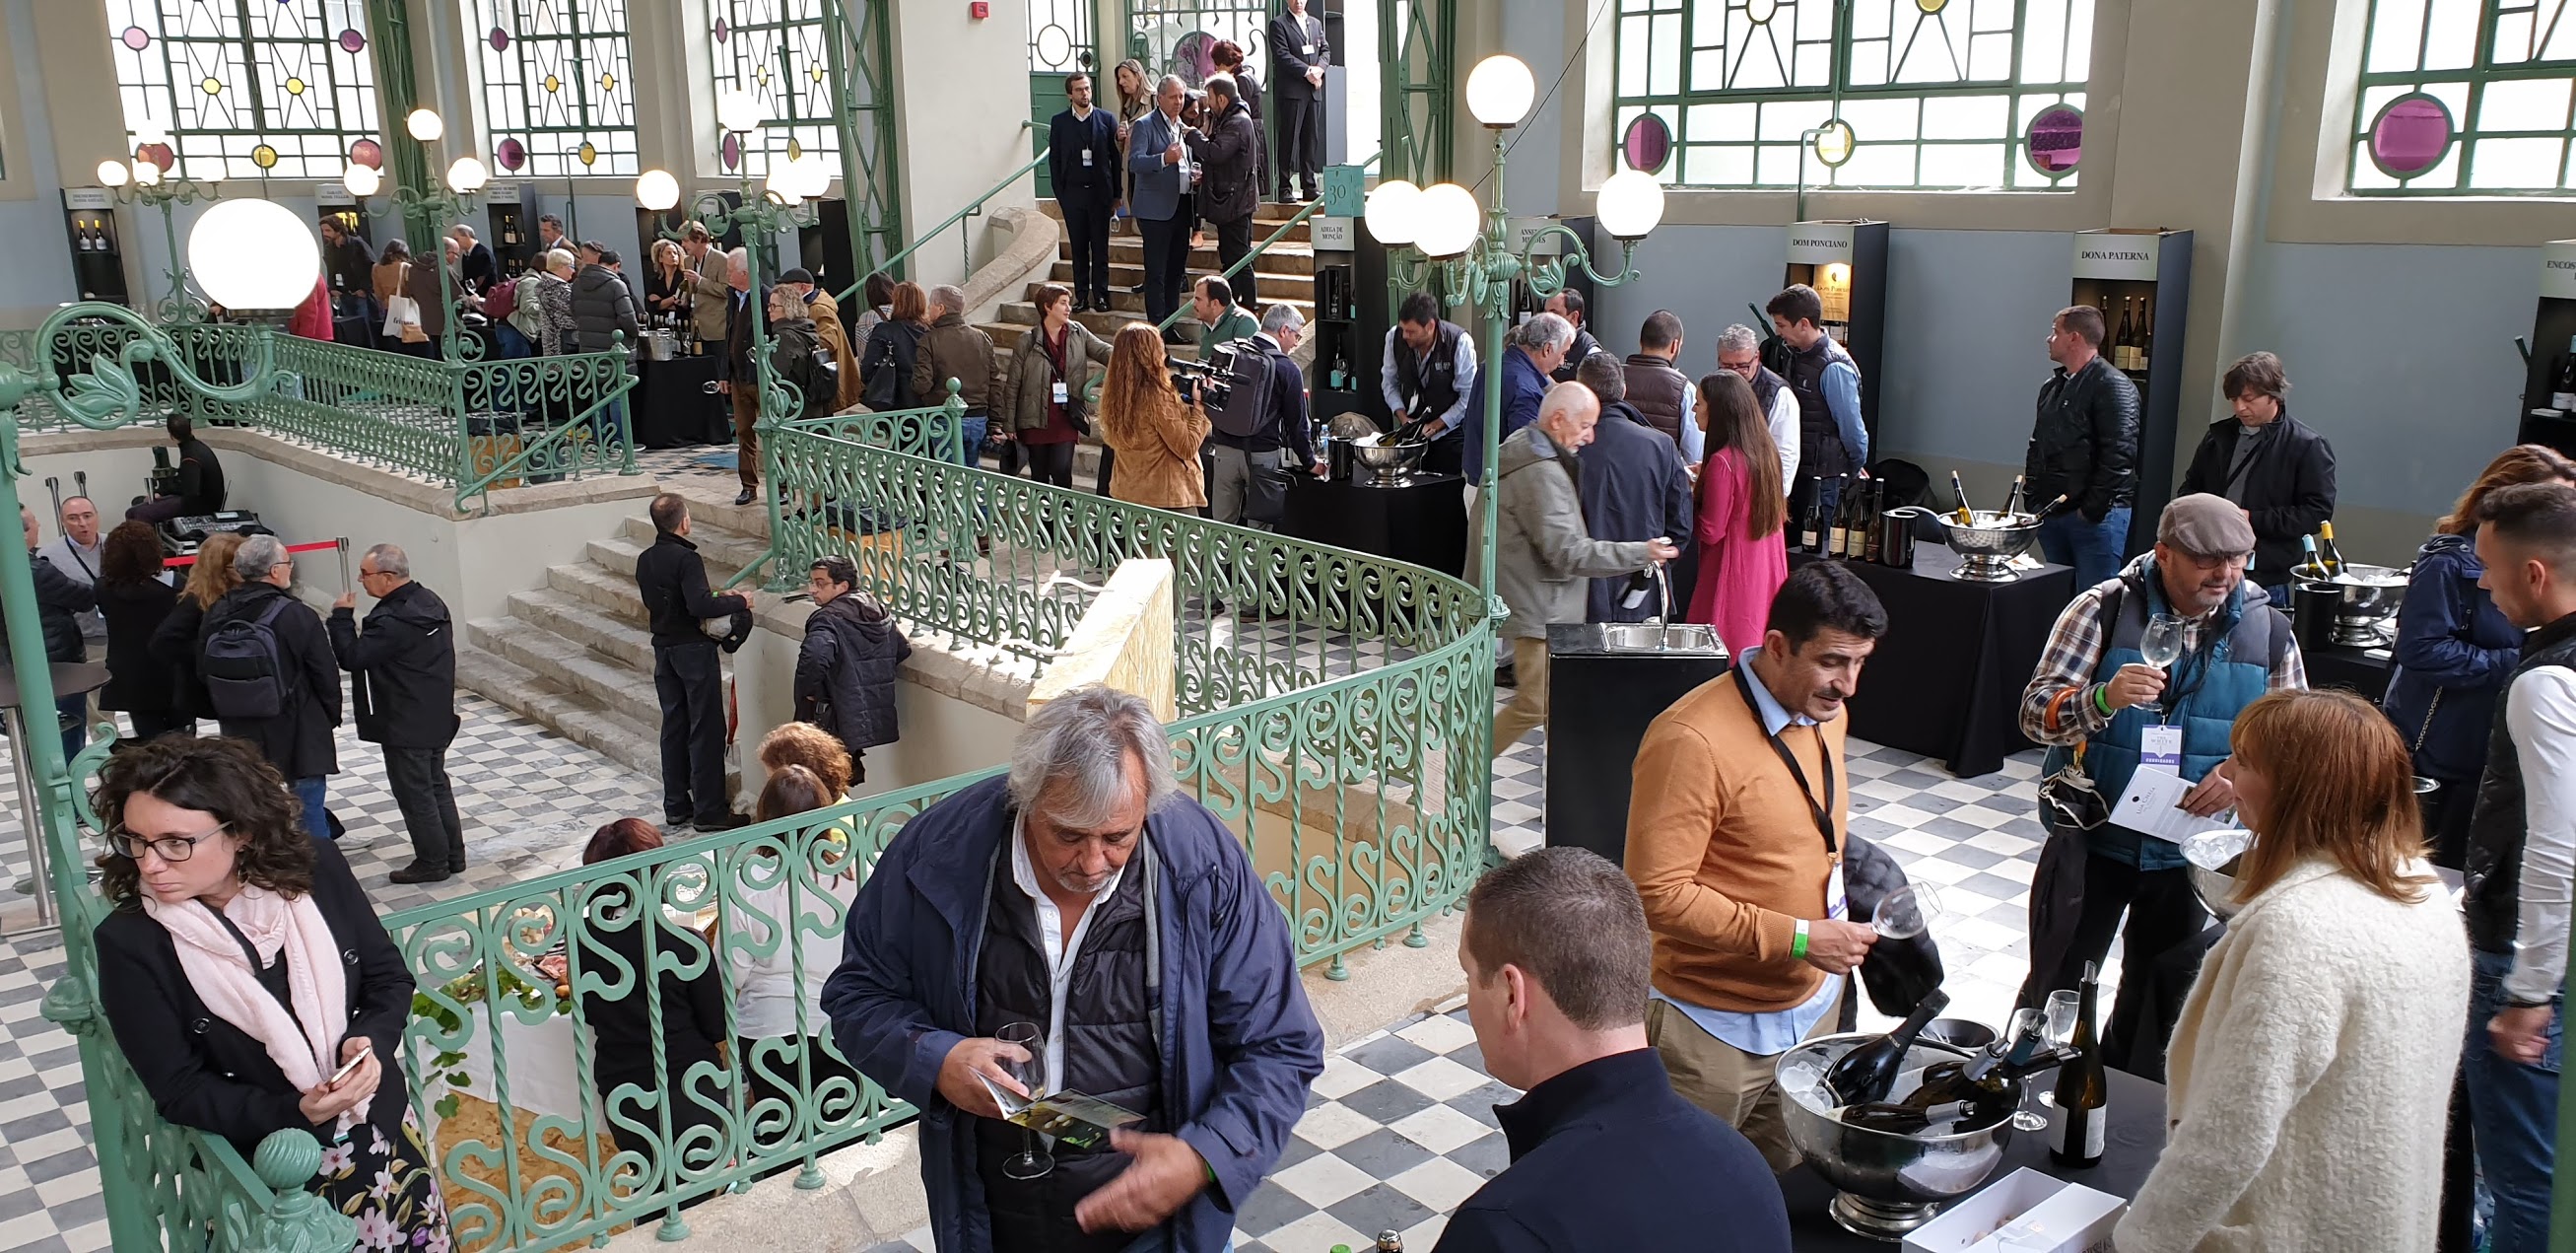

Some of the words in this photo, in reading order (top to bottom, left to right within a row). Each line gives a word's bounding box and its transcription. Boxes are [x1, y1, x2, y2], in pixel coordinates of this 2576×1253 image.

[1329, 184, 1346, 205] 30
[1810, 240, 1848, 248] PONCIANO
[2108, 251, 2149, 260] PATERNA
